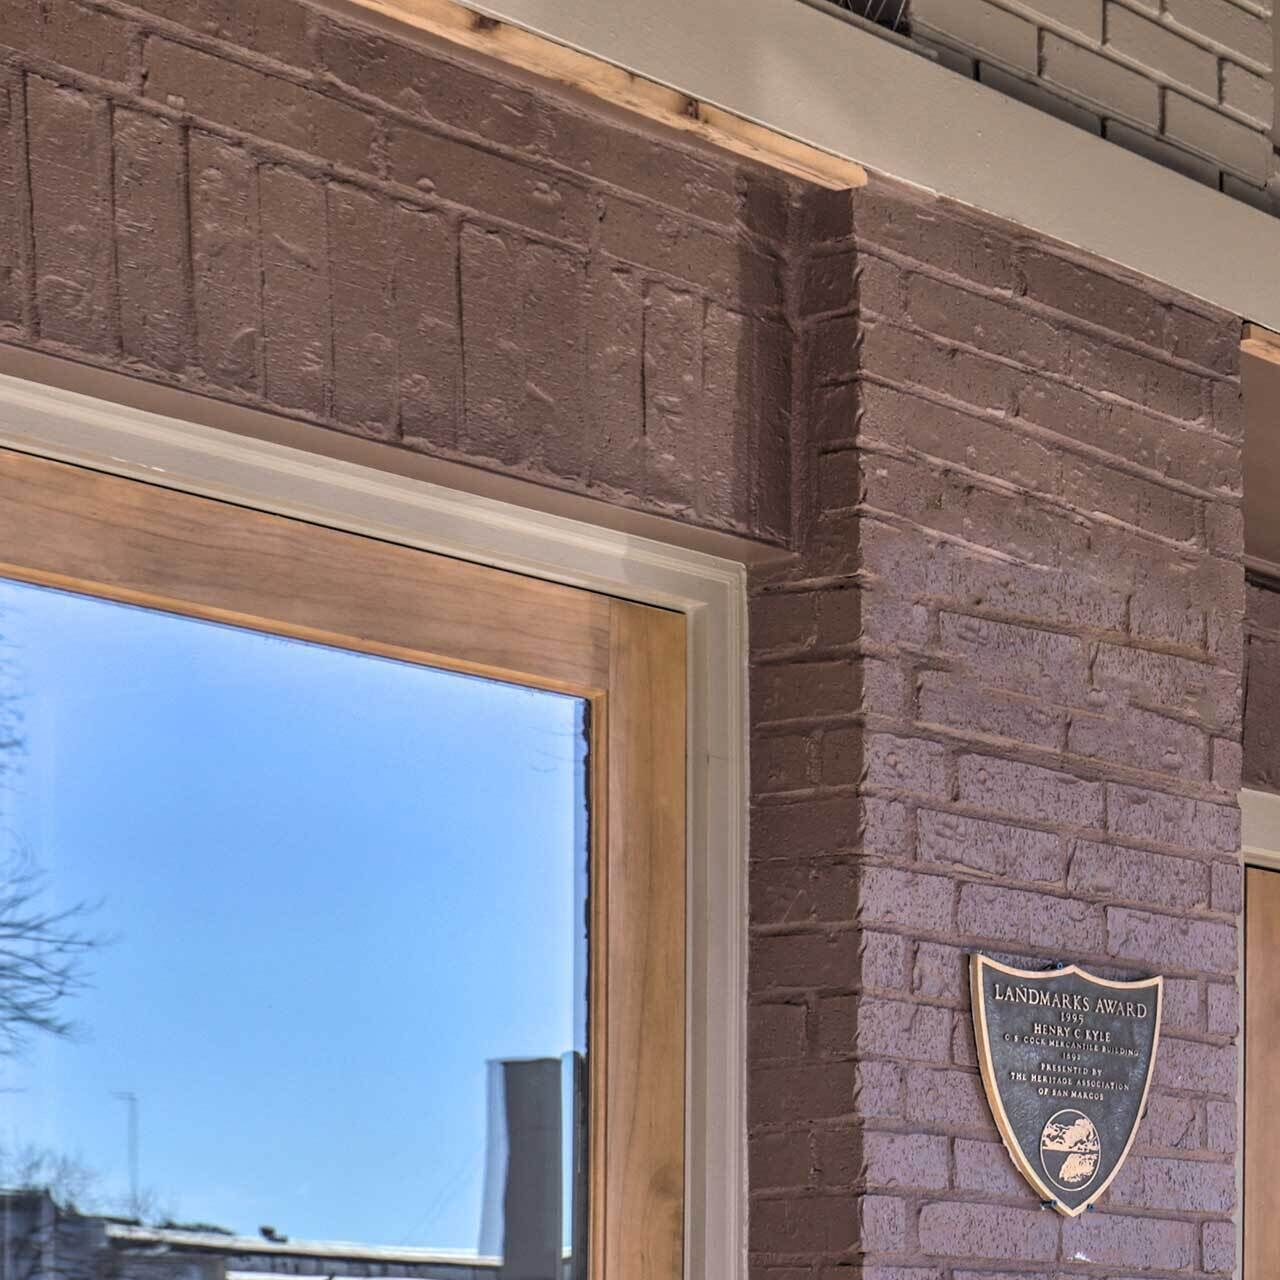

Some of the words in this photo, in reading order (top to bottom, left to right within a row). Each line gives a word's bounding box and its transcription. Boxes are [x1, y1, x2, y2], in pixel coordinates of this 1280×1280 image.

[994, 983, 1090, 1012] LANDMARKS
[1095, 998, 1148, 1018] AWARD
[1060, 1012, 1085, 1025] 1995
[1033, 1023, 1070, 1038] HENRY
[1074, 1028, 1081, 1038] C
[1085, 1030, 1112, 1043] KYLE
[1048, 1039, 1099, 1052] MERCANTILE
[1101, 1045, 1140, 1057] BUILDING
[1040, 1063, 1088, 1076] PRESENTED
[1091, 1068, 1103, 1077] BY
[1010, 1072, 1027, 1081] THE
[1031, 1073, 1073, 1086] HERITAGE
[1076, 1078, 1130, 1091] ASSOCIATION
[1038, 1087, 1049, 1096] OF
[1051, 1089, 1068, 1098] SAN
[1070, 1090, 1105, 1101] MARCOS
